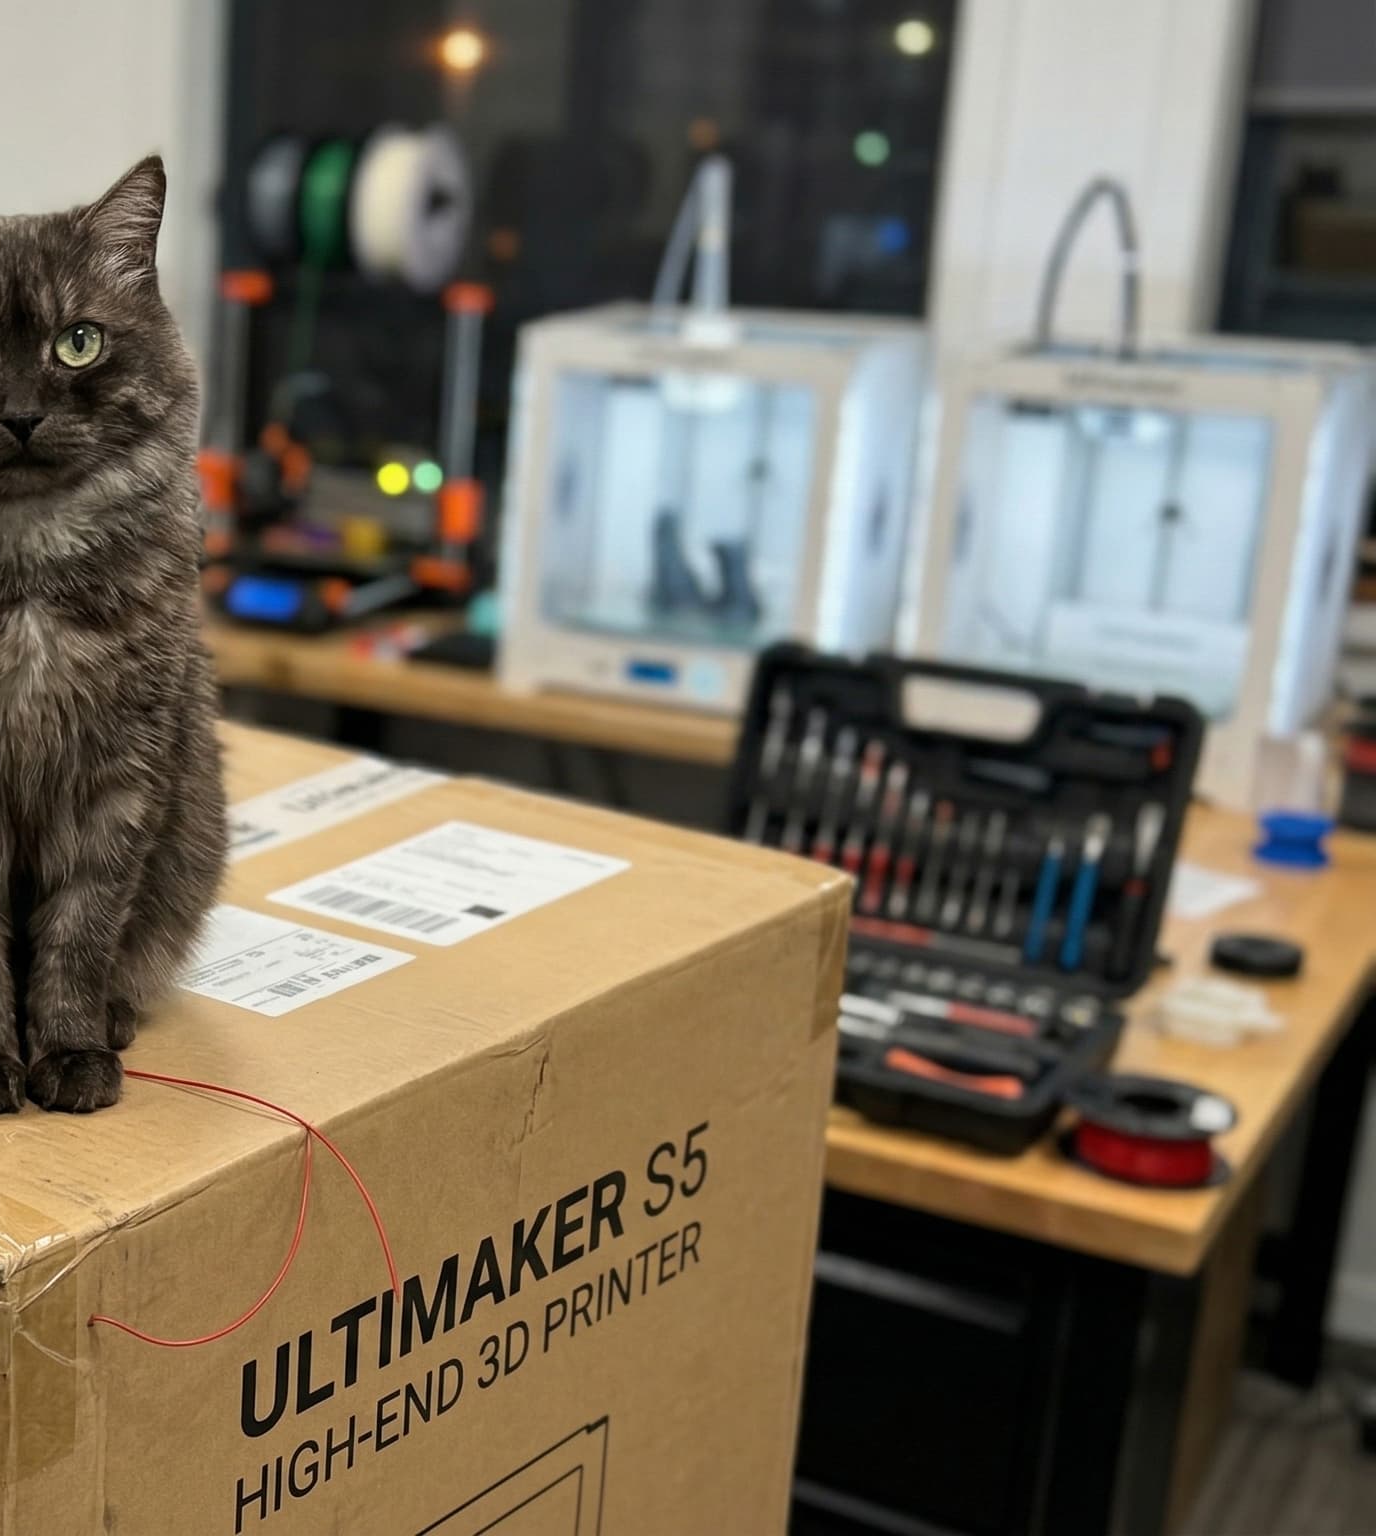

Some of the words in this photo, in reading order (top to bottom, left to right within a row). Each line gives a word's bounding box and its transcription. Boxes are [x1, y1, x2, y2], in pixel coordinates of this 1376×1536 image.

[234, 1358, 464, 1535] HIGH-END
[478, 1321, 530, 1390] 3D
[543, 1221, 702, 1353] PRINTER
[239, 1170, 627, 1439] ULTIMAKER
[643, 1121, 709, 1219] S5
